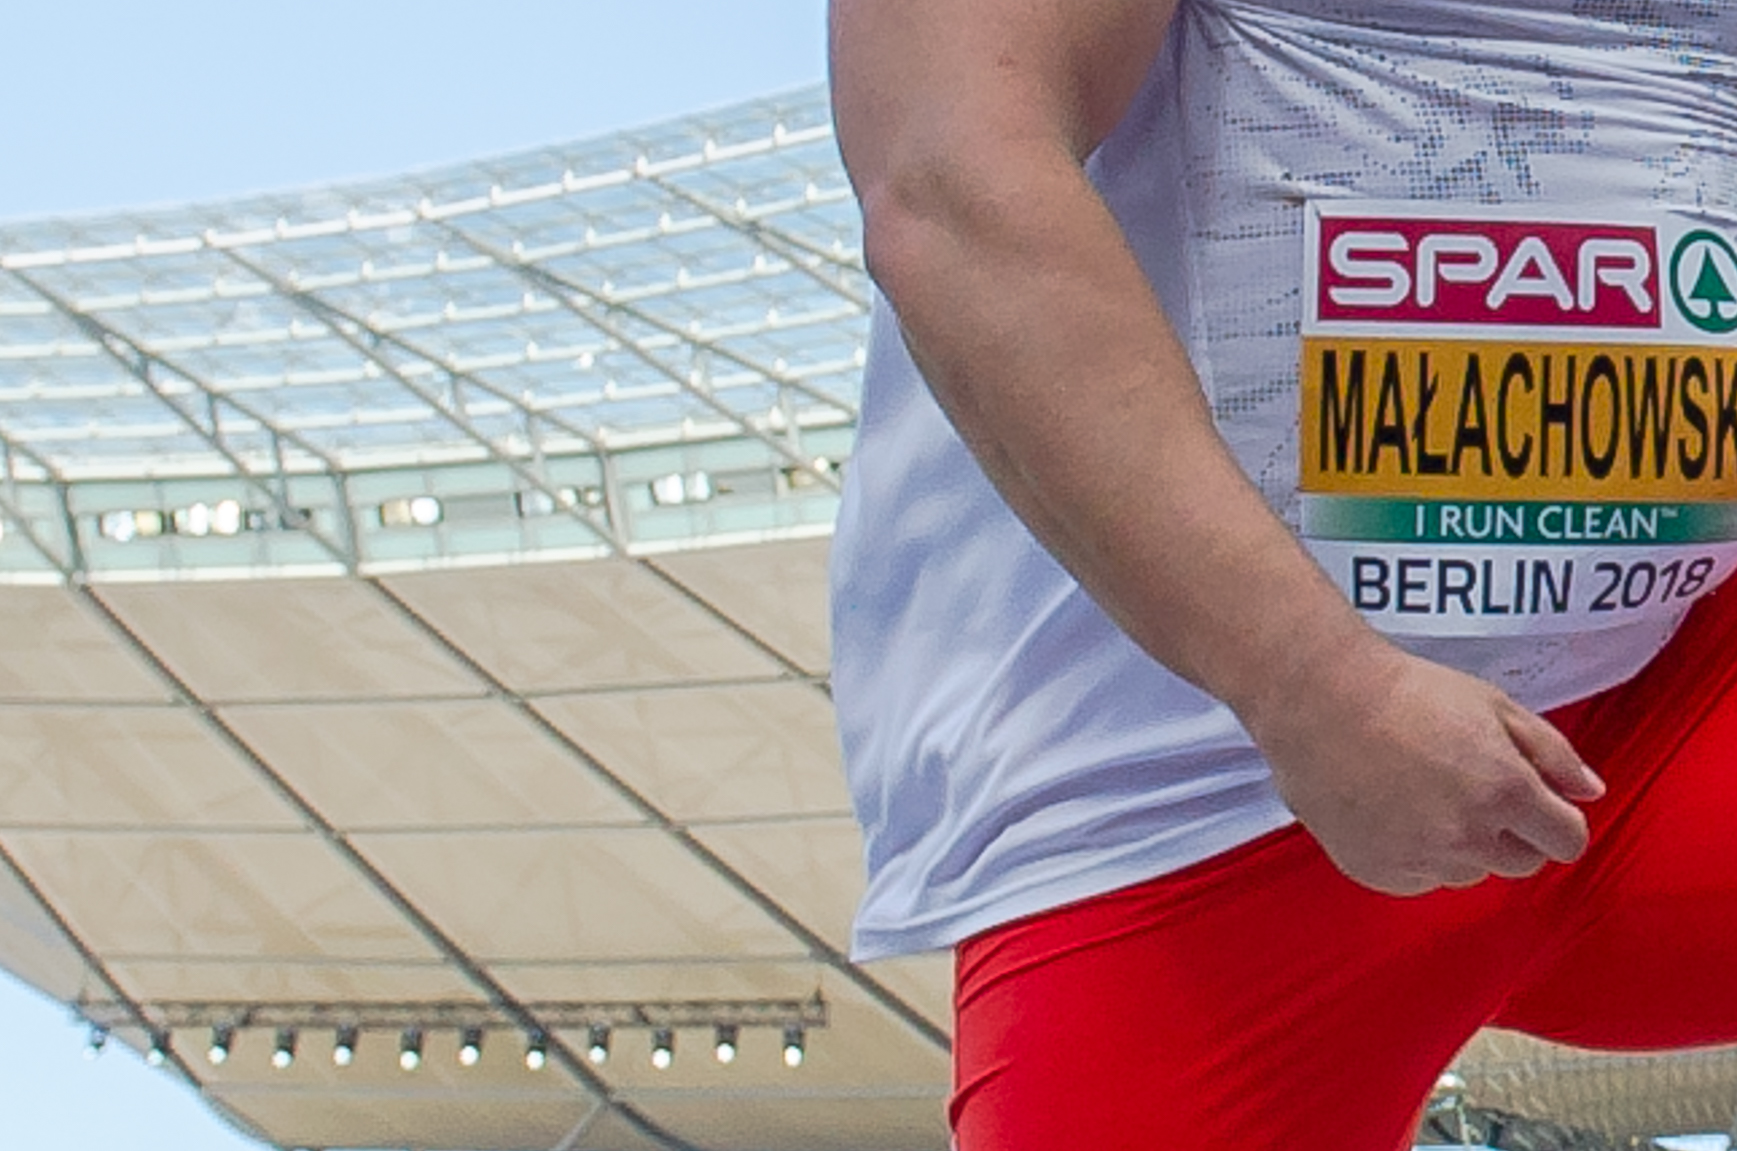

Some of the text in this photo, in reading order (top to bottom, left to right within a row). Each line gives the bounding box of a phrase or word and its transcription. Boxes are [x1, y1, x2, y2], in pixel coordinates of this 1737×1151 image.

[1328, 231, 1654, 313] SPAR
[1415, 504, 1425, 537] I
[1440, 505, 1524, 539] RUN
[1352, 556, 1715, 614] BERLIN 2018
